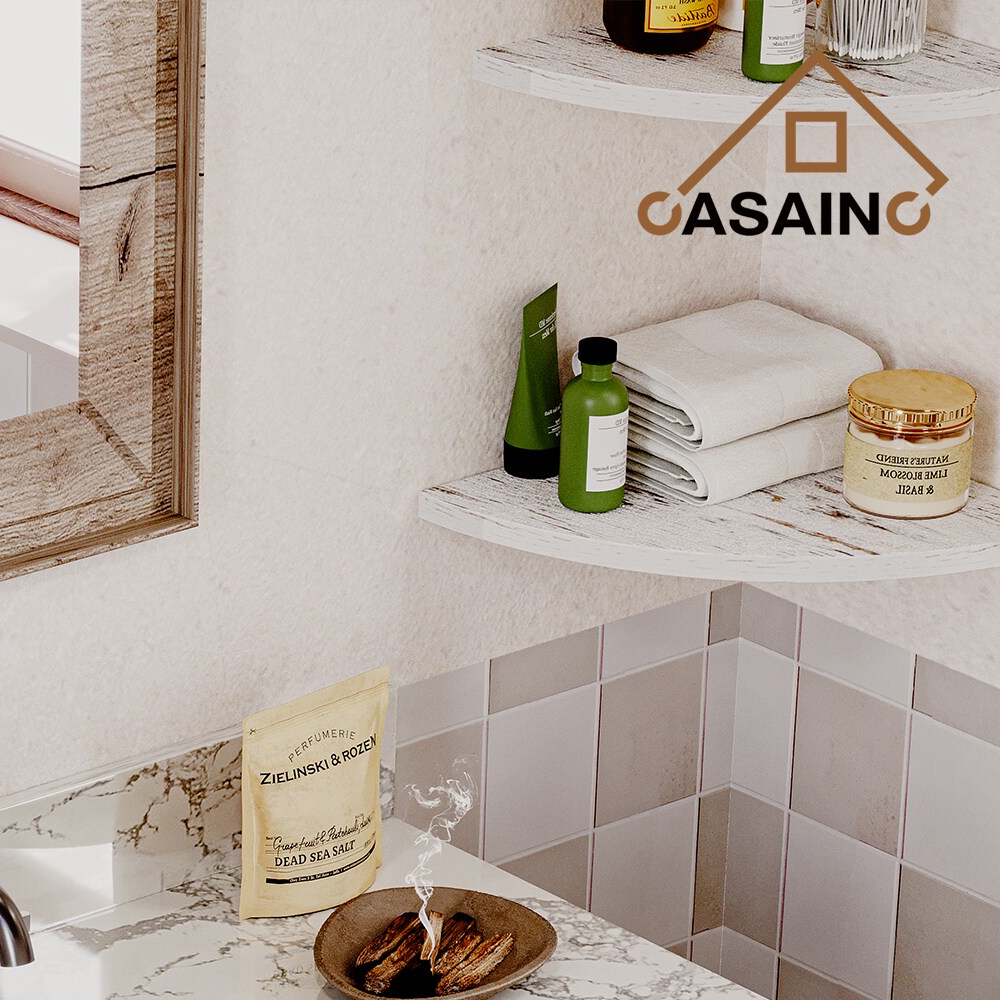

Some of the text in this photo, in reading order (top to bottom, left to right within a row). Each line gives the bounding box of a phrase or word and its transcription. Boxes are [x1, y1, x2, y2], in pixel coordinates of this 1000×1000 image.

[259, 732, 378, 786] ZIELINSKI & ROZEN
[287, 728, 357, 763] PERFUMERIE
[274, 853, 307, 867] DEAD
[309, 848, 331, 863] SEA
[332, 839, 356, 857] SALT
